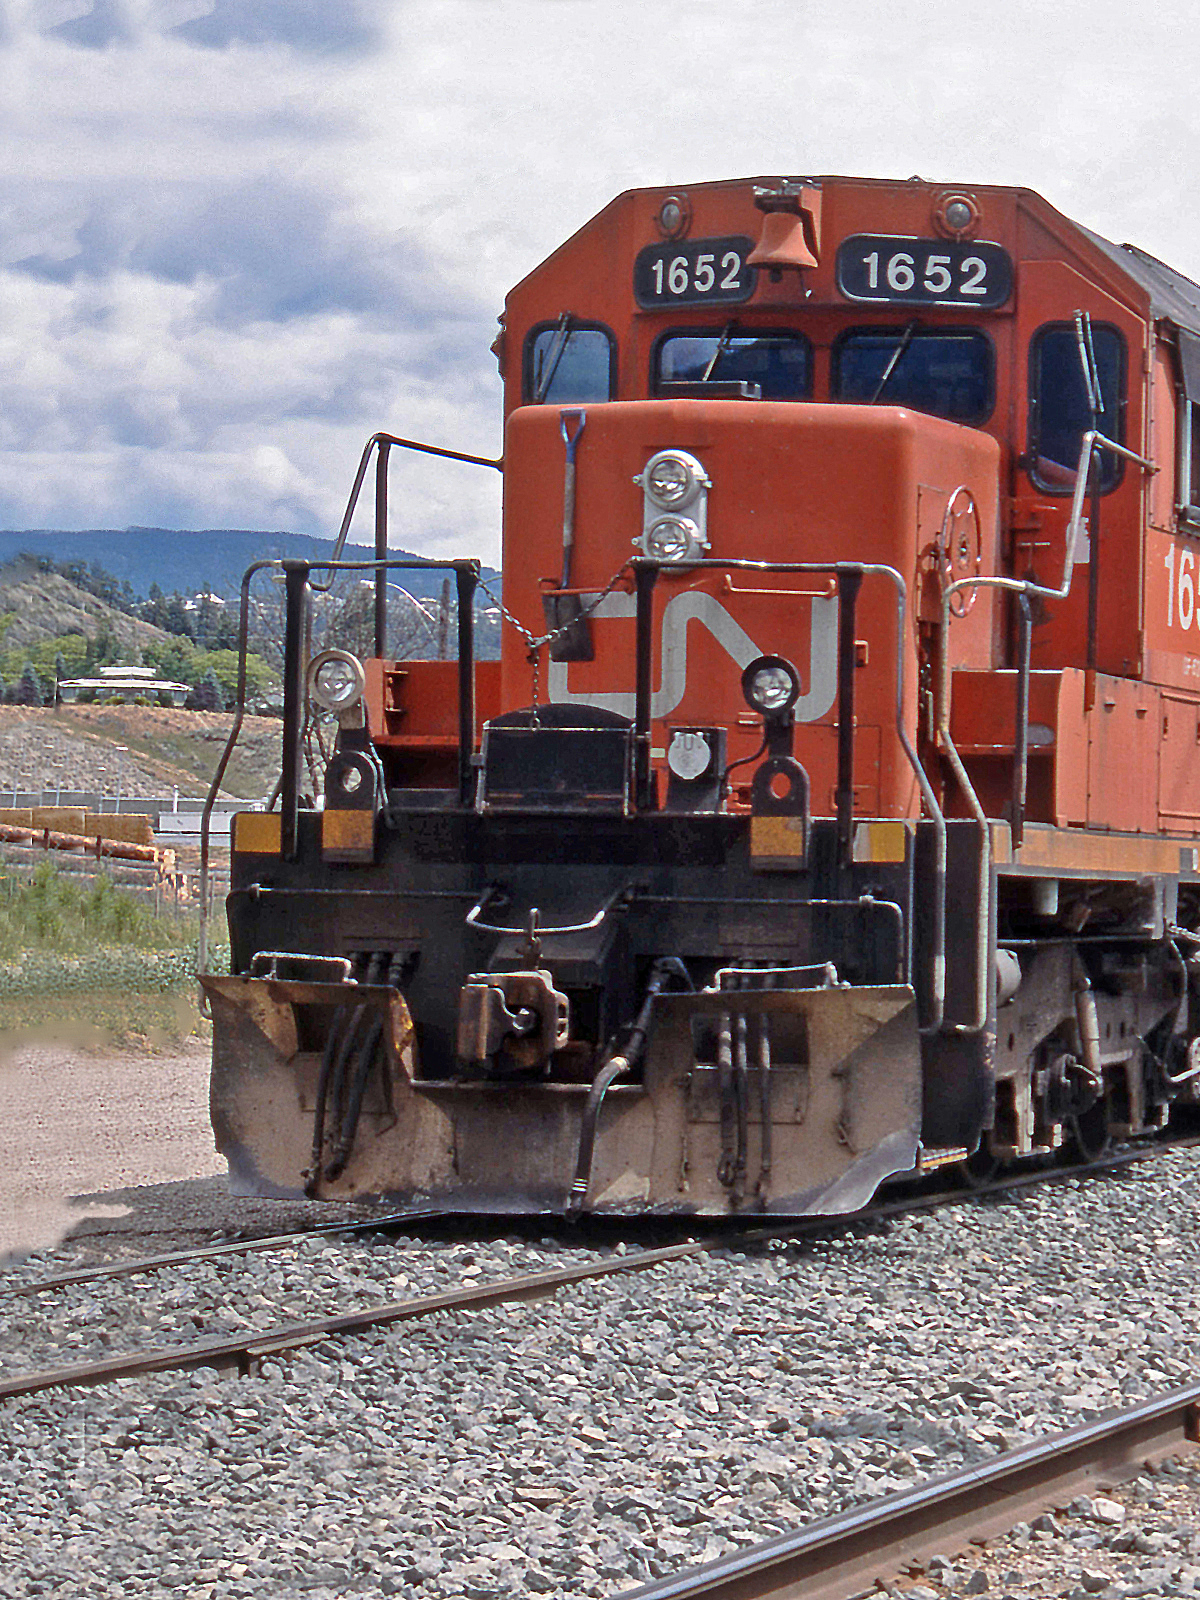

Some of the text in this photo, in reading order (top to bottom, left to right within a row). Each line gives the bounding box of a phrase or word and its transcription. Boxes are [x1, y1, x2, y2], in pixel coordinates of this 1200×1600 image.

[652, 251, 741, 295] 1652
[863, 251, 988, 296] 1652
[549, 590, 839, 722] CN
